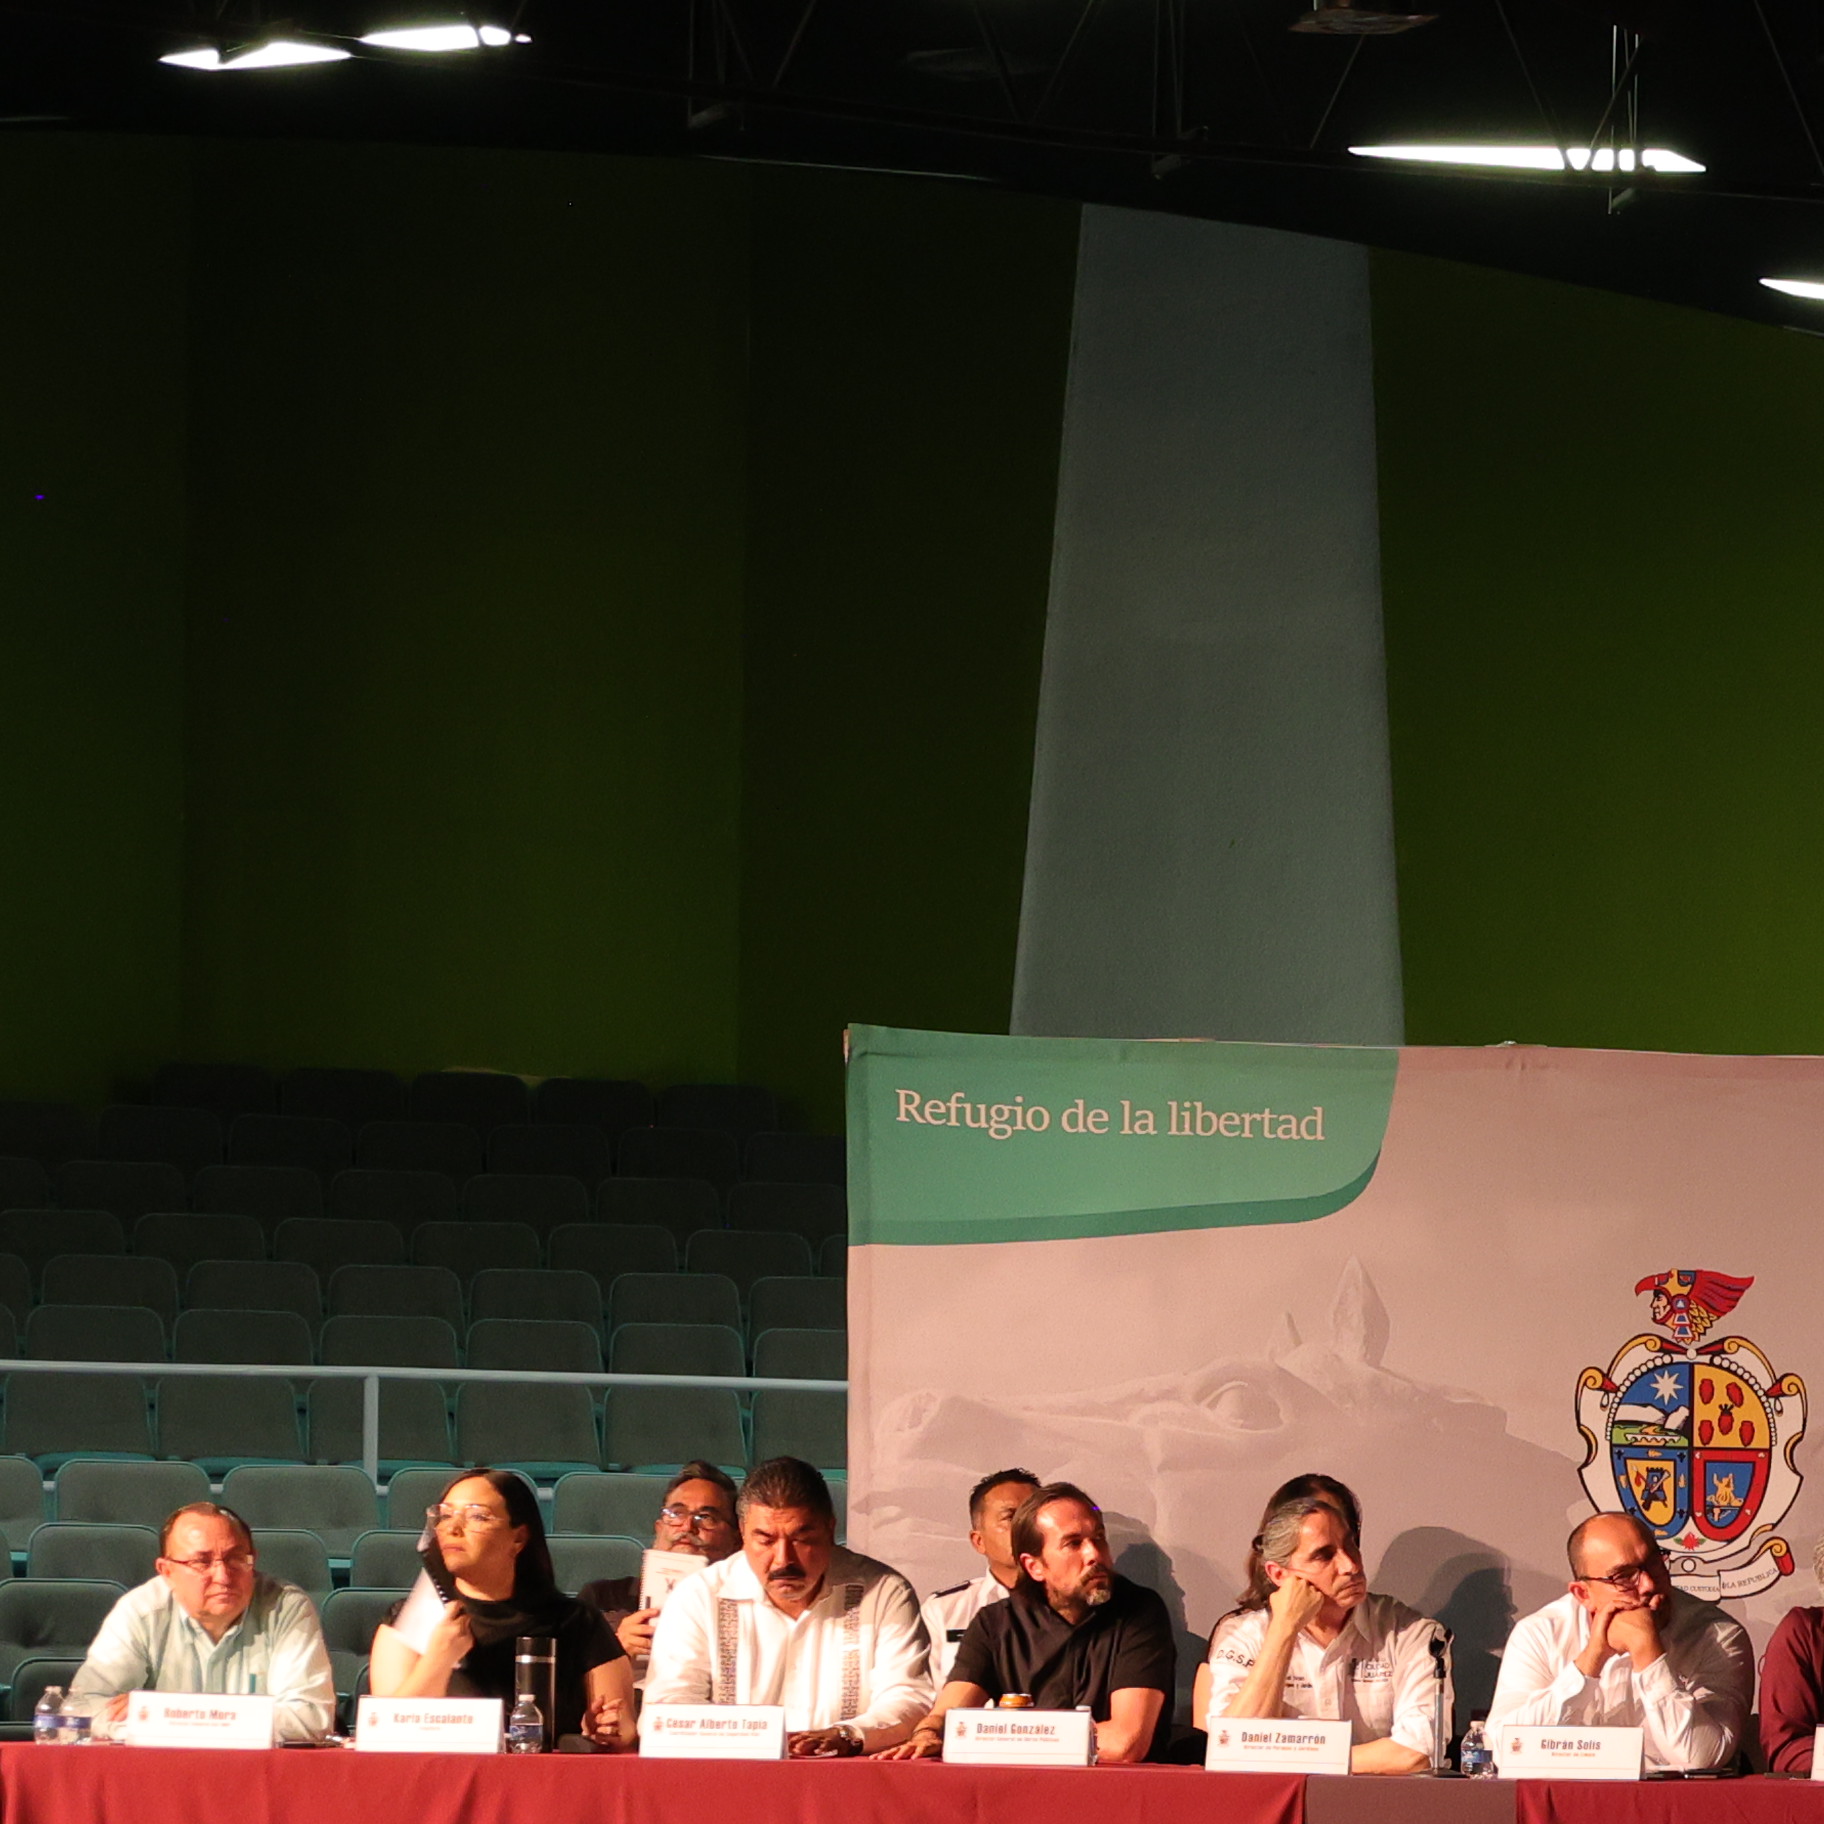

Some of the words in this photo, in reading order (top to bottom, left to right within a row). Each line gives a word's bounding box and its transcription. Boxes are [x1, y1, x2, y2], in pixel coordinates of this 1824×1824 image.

[896, 1089, 1049, 1140] Refugio
[1061, 1099, 1109, 1135] de
[1120, 1100, 1157, 1135] la
[1168, 1100, 1325, 1141] libertad
[164, 1707, 206, 1720] Roberto
[209, 1709, 237, 1720] Mora
[424, 1713, 474, 1725] Escalante
[700, 1718, 738, 1730] Alberto
[742, 1718, 768, 1731] Tapia
[977, 1722, 1007, 1735] Daniel
[1241, 1731, 1272, 1743] Daniel
